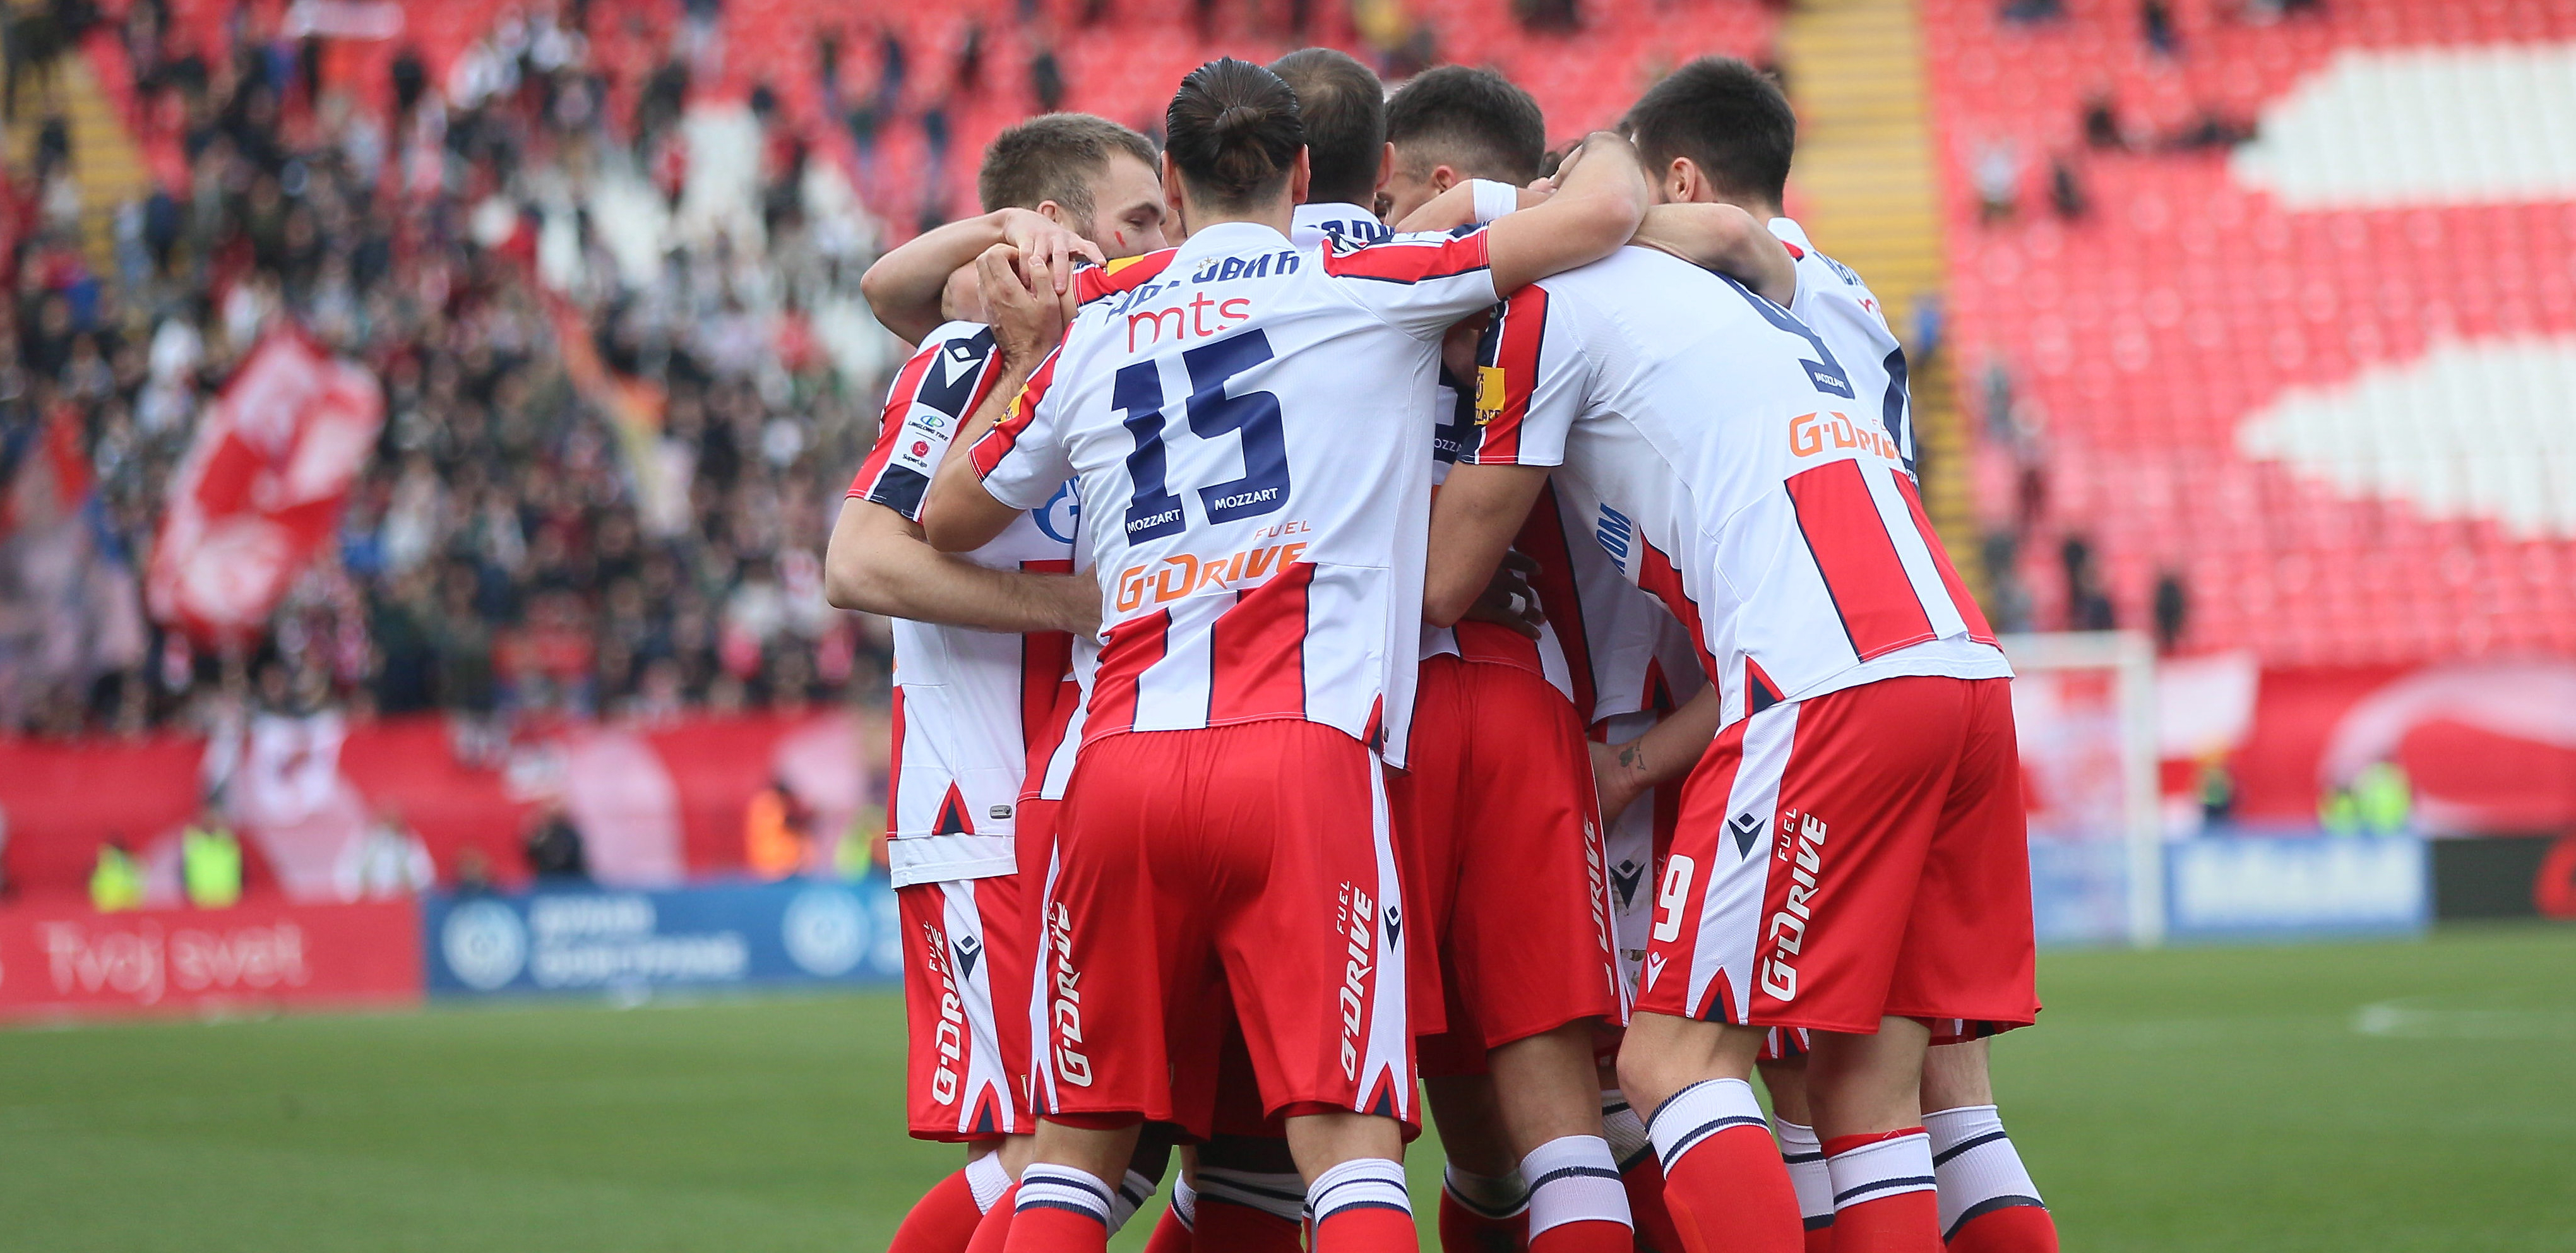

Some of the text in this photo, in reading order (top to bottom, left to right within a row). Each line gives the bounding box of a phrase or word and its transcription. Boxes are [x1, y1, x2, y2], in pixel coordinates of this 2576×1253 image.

[1128, 292, 1250, 353] mts
[936, 431, 949, 442] TIRE
[1111, 328, 1291, 547] 15
[1127, 509, 1180, 533] MOZZART
[1215, 487, 1278, 510] MOZZART
[1254, 521, 1311, 540] FUEL
[1778, 808, 1798, 862] FUEL
[1337, 881, 1351, 935] FUEL
[1653, 854, 1695, 942] 9
[923, 921, 938, 971] FUEL
